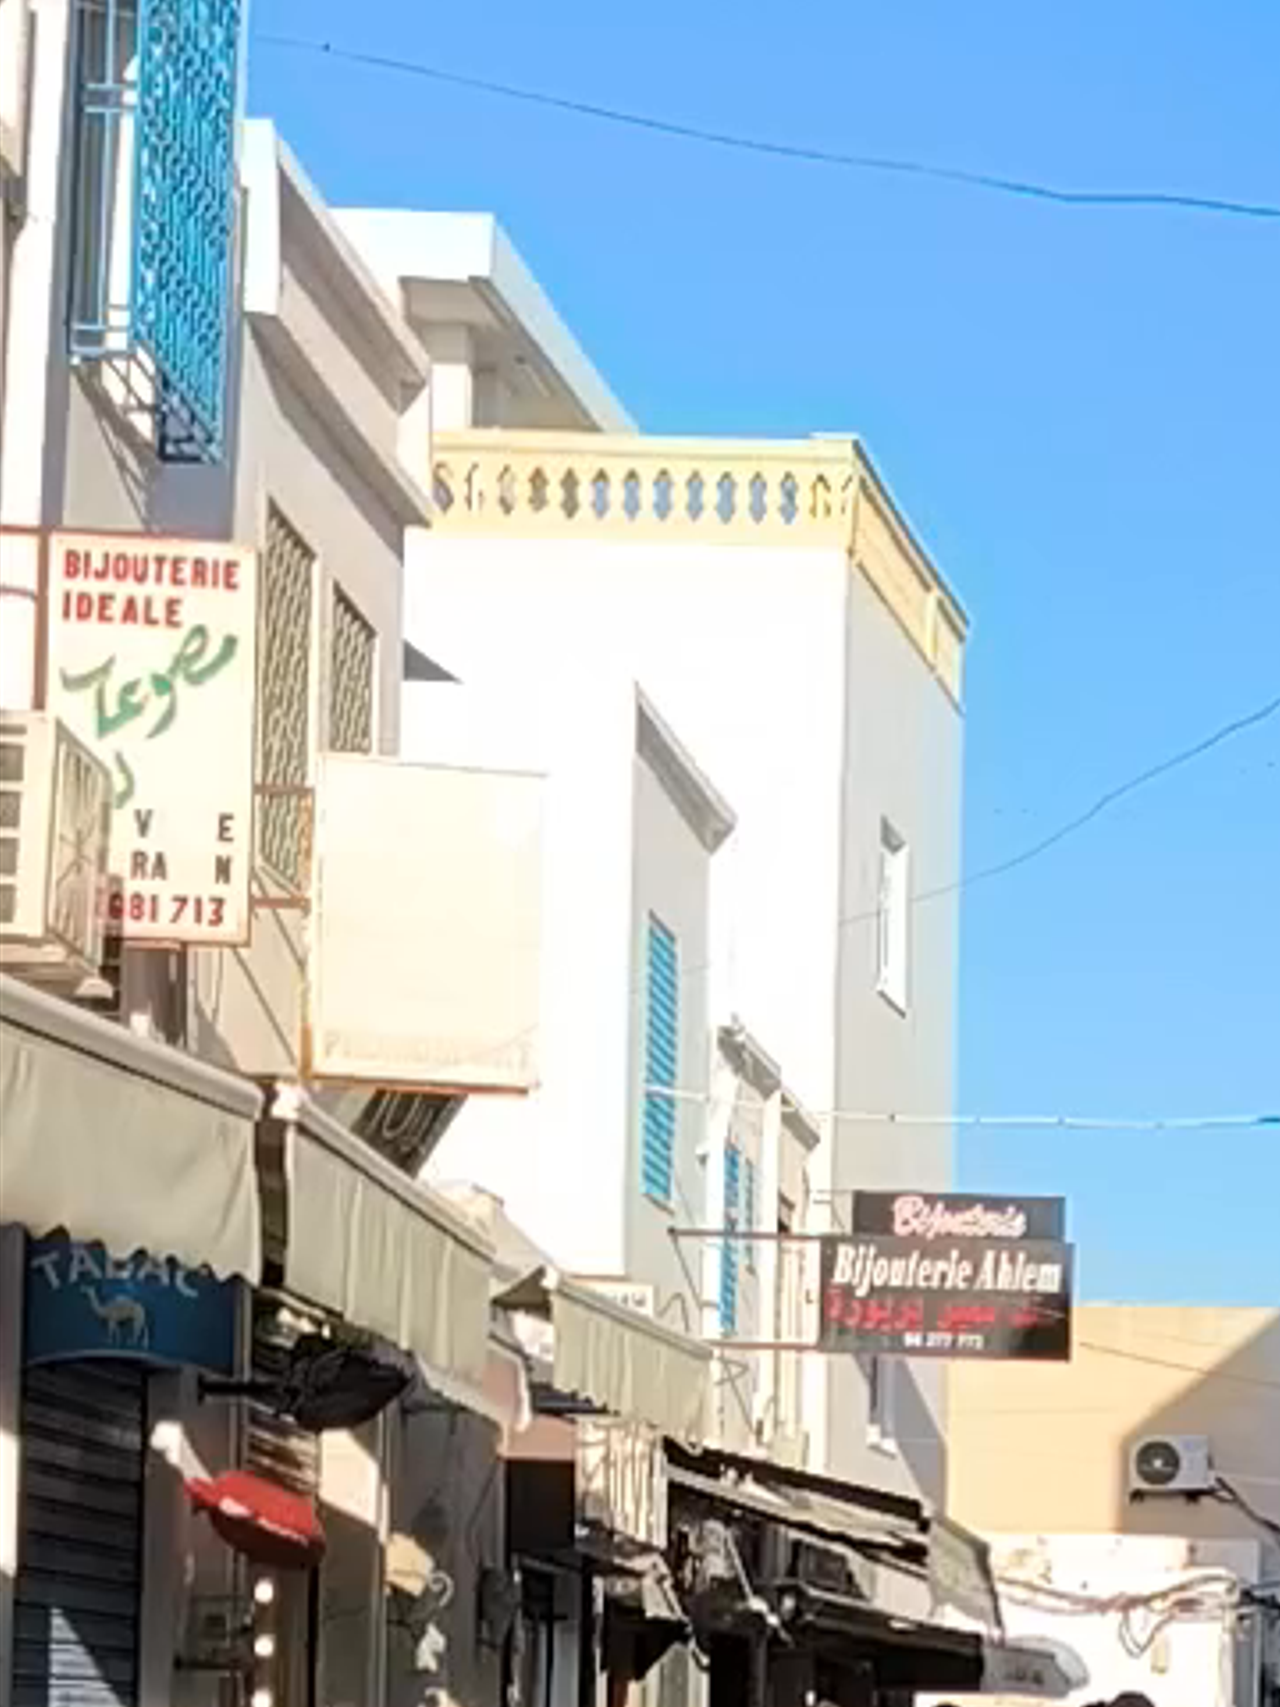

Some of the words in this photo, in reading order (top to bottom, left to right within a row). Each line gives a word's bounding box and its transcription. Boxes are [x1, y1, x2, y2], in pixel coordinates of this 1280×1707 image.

[63, 549, 240, 590] BIJOUTERIE
[62, 592, 183, 628] IDEALE
[134, 809, 153, 839] V
[217, 813, 235, 843] E
[130, 849, 167, 881] RA
[215, 854, 233, 885] N
[169, 895, 226, 928] 713
[832, 1244, 974, 1298] Bijouterie
